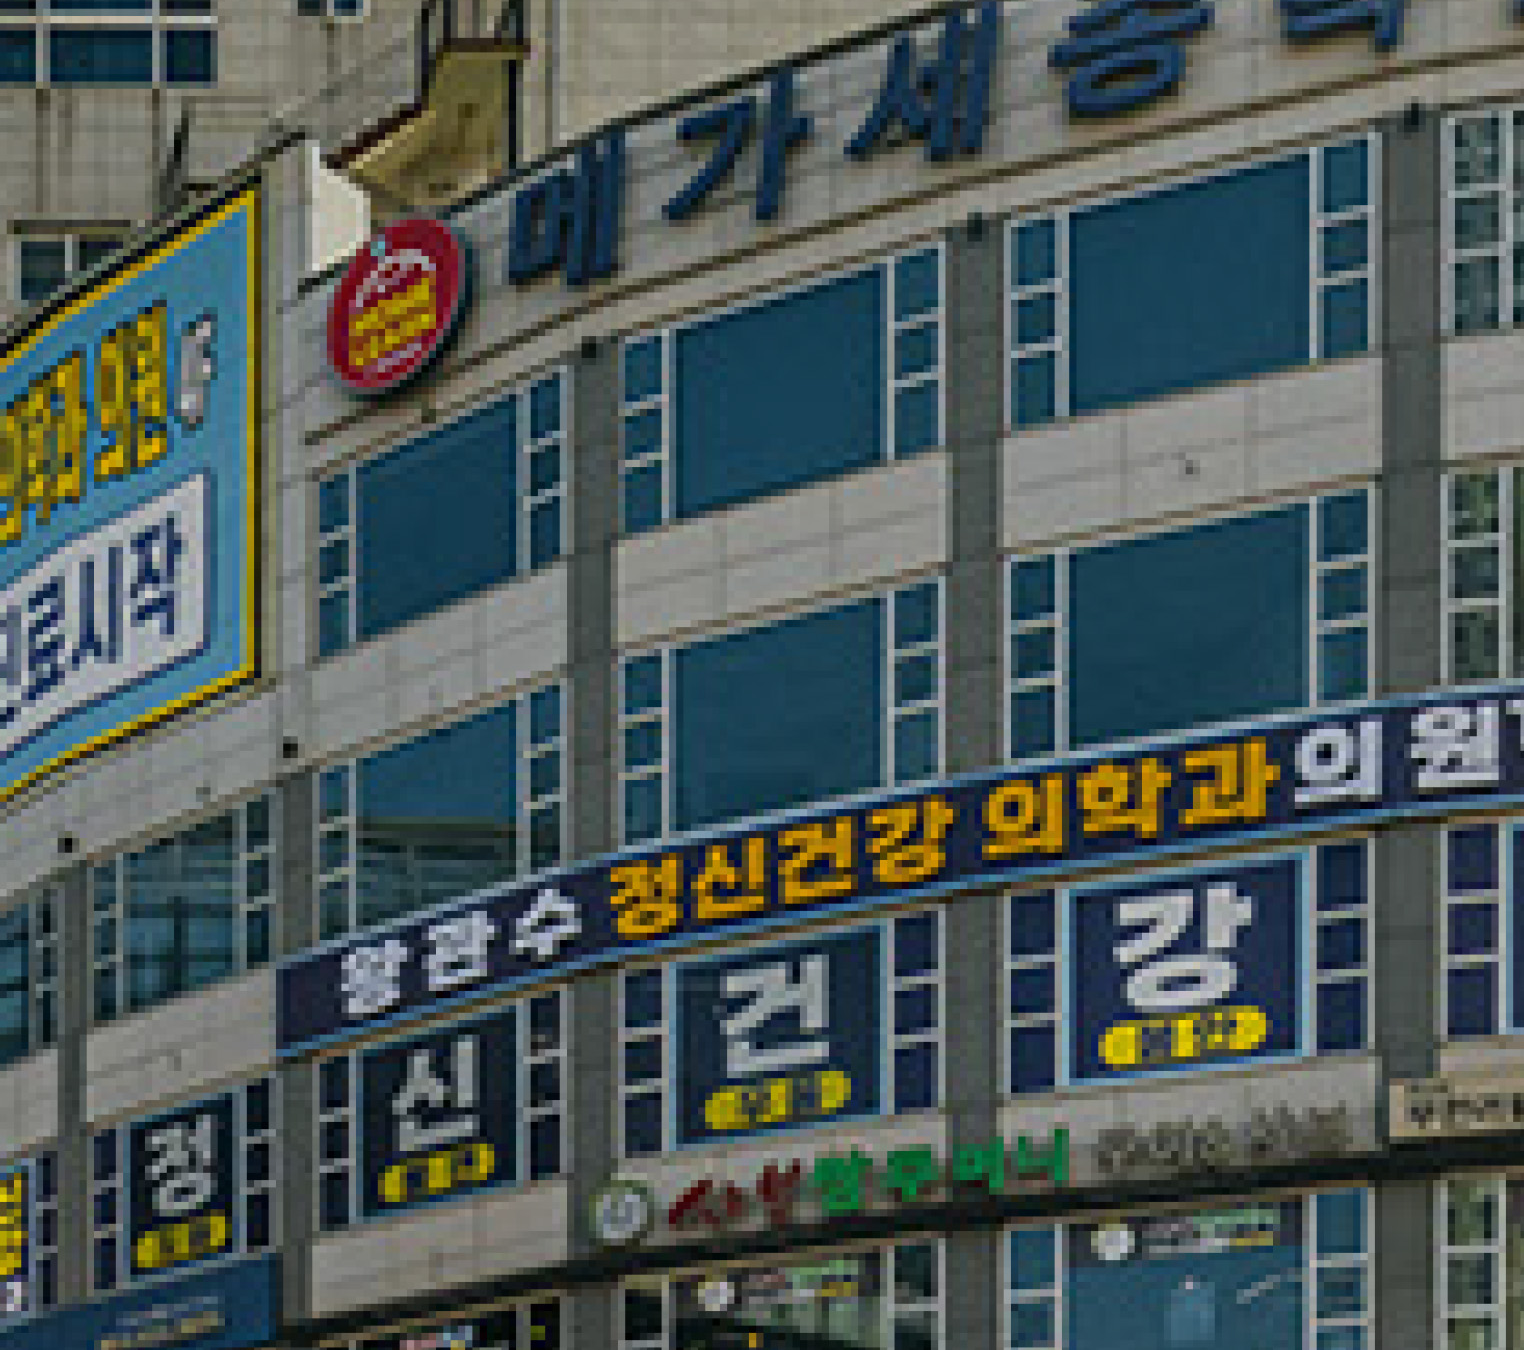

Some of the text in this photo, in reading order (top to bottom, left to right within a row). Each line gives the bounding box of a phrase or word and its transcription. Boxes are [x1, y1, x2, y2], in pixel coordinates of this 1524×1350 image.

[607, 795, 955, 936] 정신건강
[982, 739, 1282, 862] 의학과
[146, 1114, 215, 1216] 정
[390, 1033, 479, 1151] 신
[721, 946, 831, 1079] 건
[1114, 882, 1252, 1009] 강
